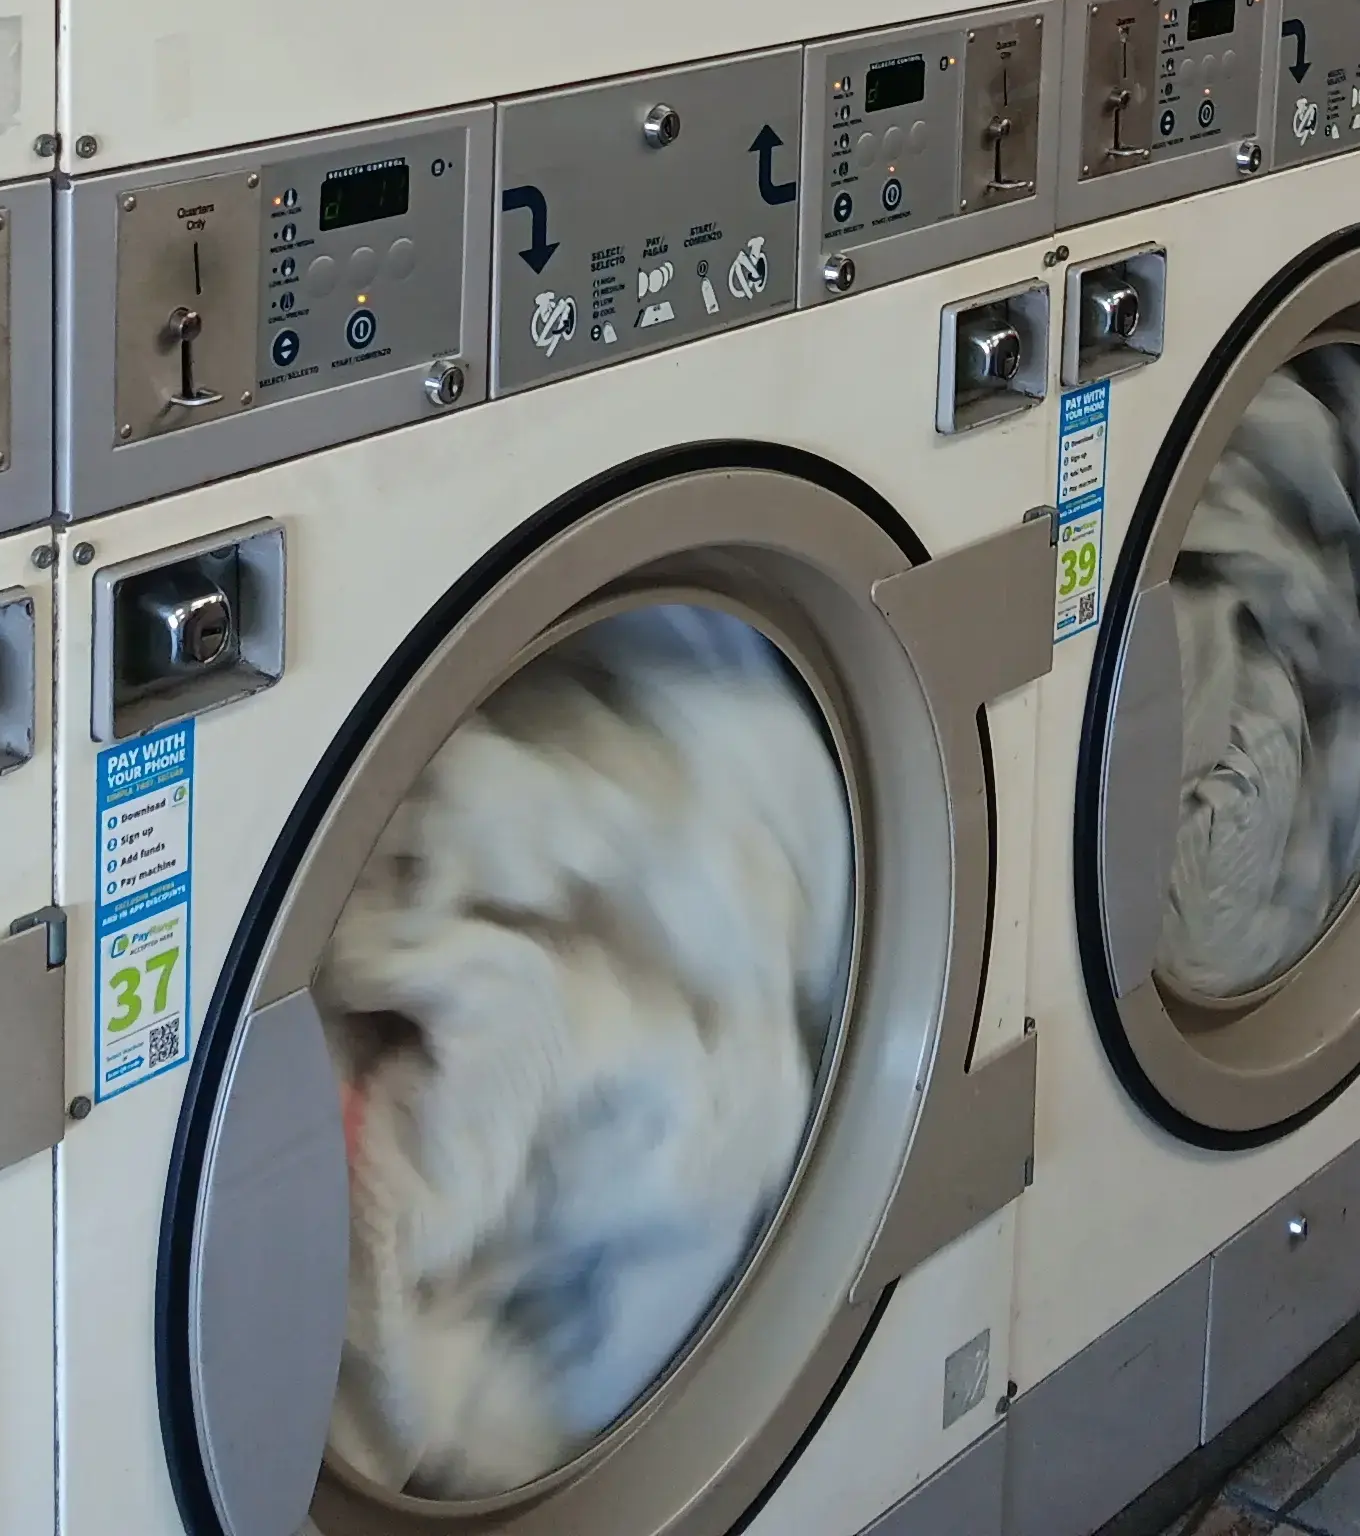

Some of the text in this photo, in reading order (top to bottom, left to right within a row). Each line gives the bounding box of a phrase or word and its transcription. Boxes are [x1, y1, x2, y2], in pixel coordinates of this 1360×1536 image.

[177, 204, 214, 219] Quarters
[1065, 387, 1105, 411] PAY WITH
[1065, 408, 1082, 421] YOUR
[1059, 542, 1096, 595] 39
[107, 731, 186, 774] PAY WITH
[108, 765, 142, 788] YOUR
[144, 748, 186, 775] PHONE
[121, 798, 166, 824] Download
[121, 831, 140, 846] Sign
[142, 826, 154, 838] up
[120, 852, 138, 867] Add
[140, 842, 165, 858] funds
[120, 874, 136, 887] Pay
[139, 859, 176, 881] machine
[107, 946, 179, 1033] 37
